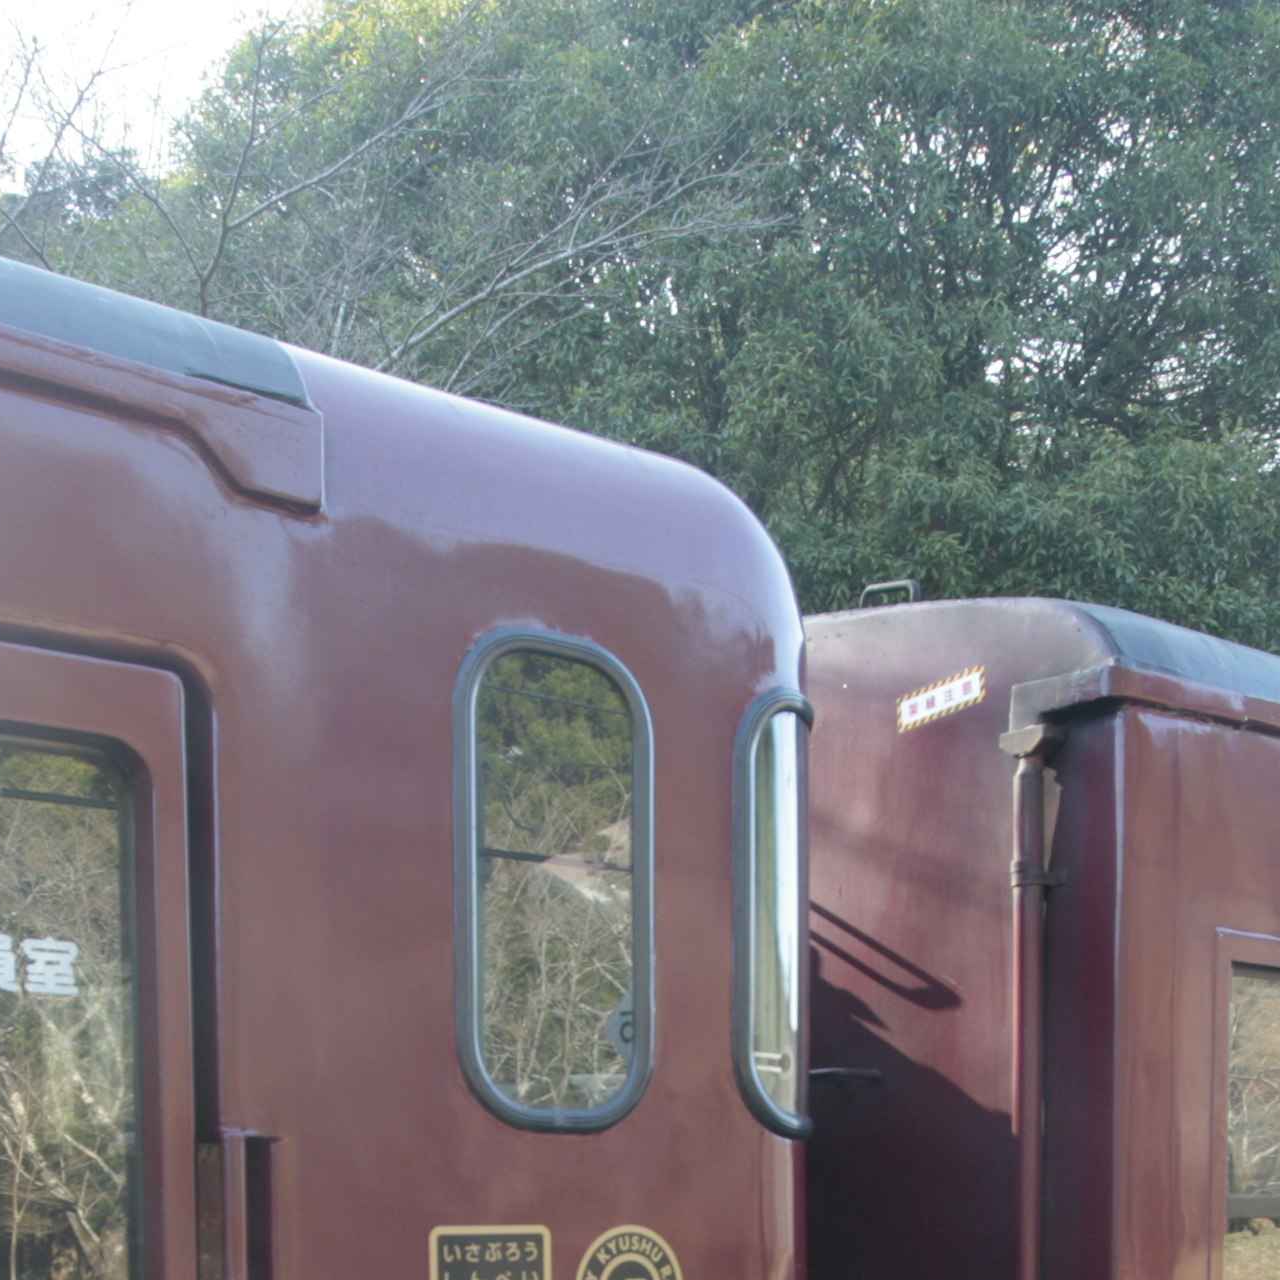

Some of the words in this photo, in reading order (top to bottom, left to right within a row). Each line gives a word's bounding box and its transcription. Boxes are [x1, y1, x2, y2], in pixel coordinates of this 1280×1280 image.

[442, 1241, 539, 1263] いさぶろう
[596, 1235, 664, 1265] KYUSHU
